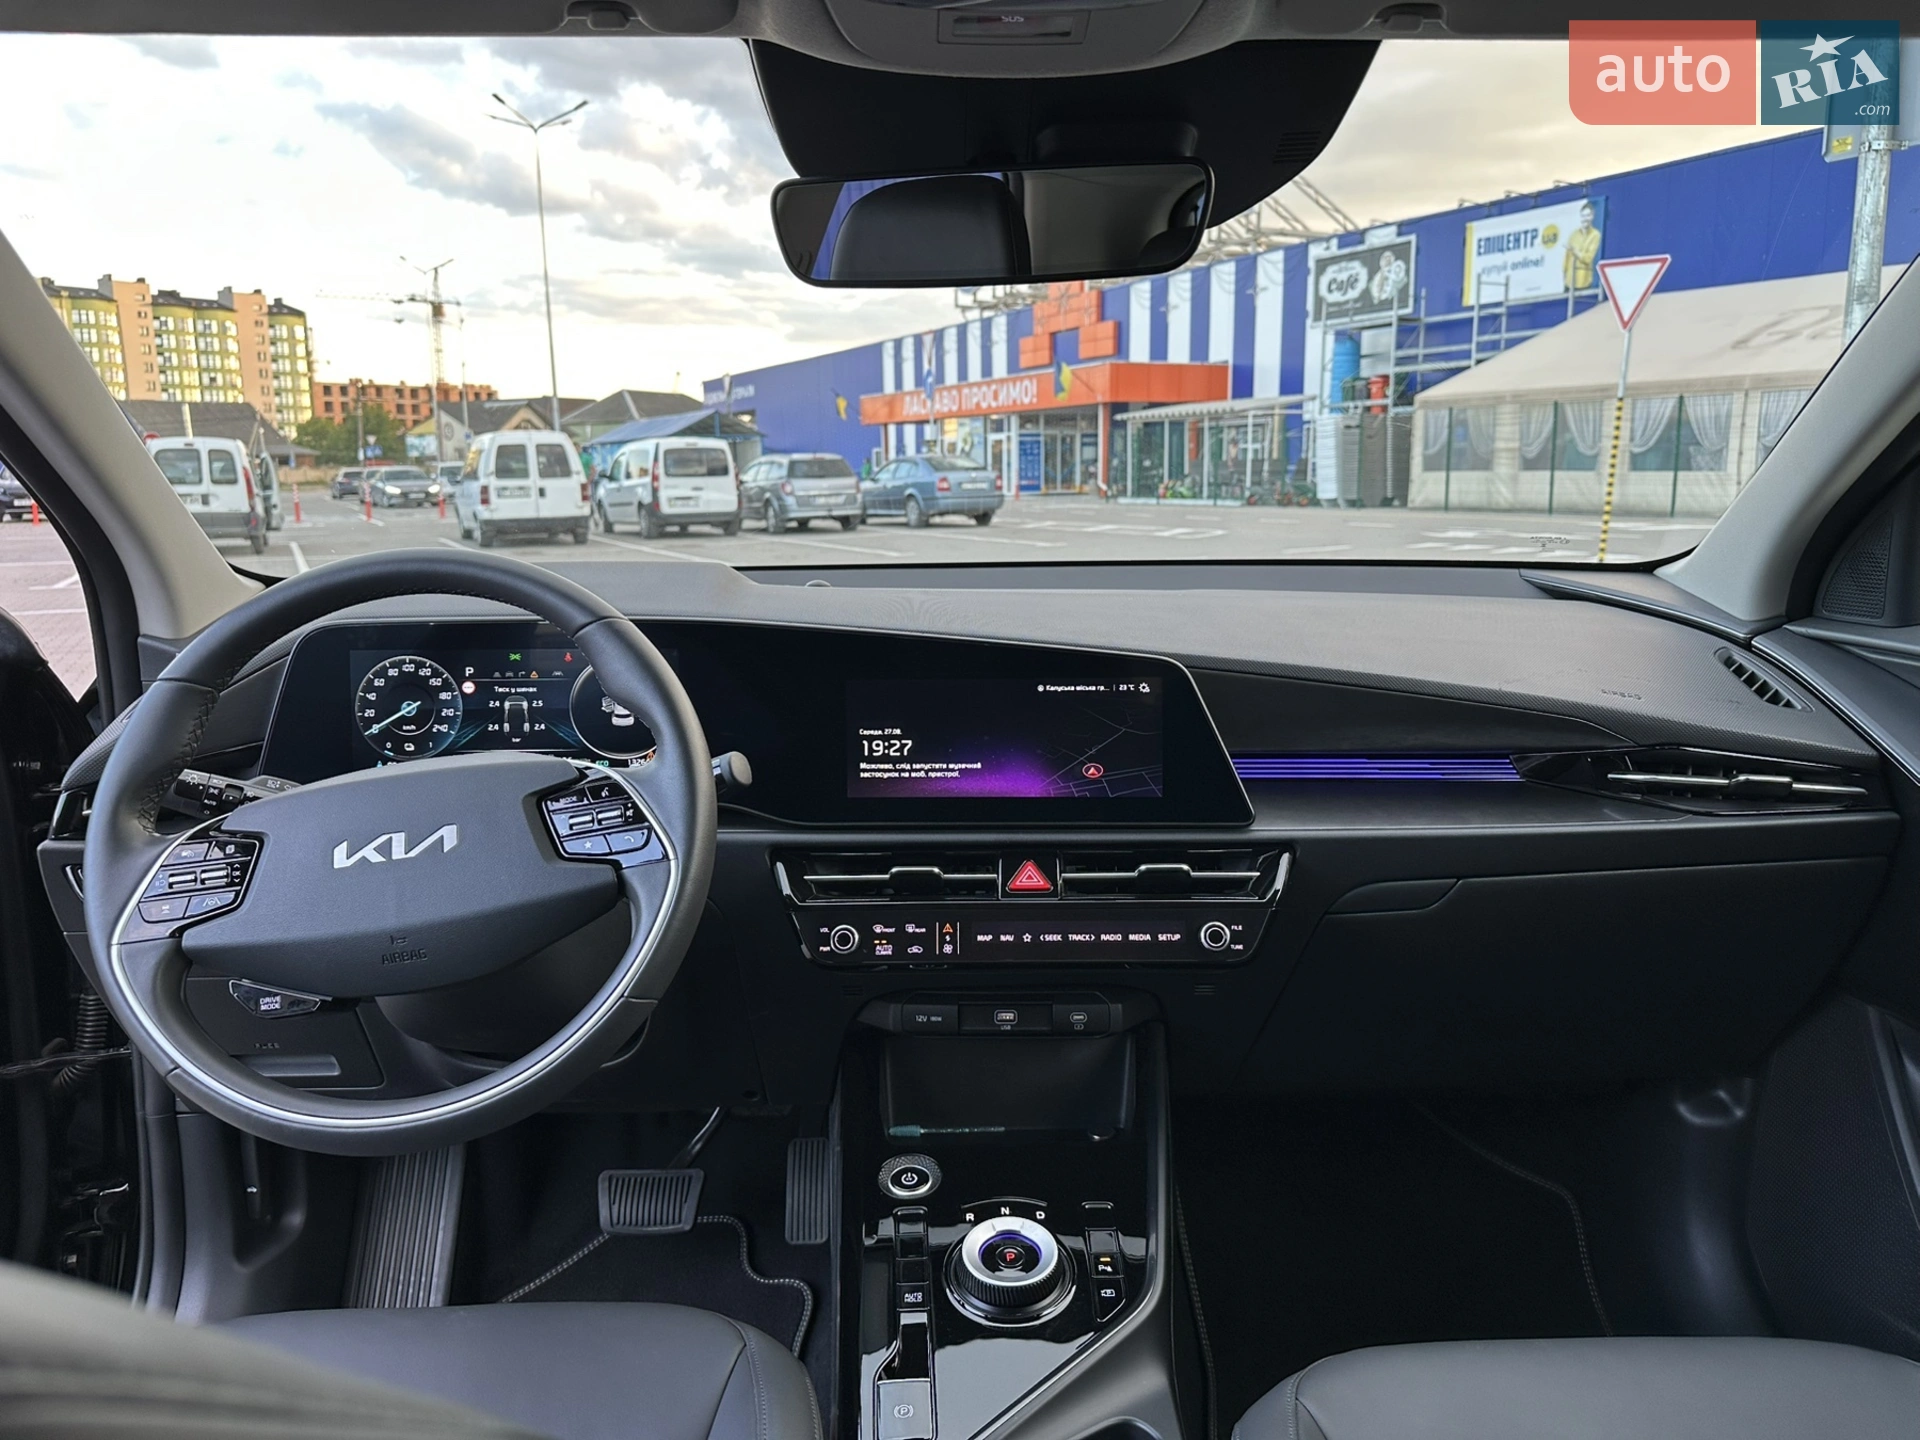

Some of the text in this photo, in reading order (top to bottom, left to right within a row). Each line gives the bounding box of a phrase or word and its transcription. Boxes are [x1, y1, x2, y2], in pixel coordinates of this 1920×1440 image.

[1477, 228, 1539, 256] ЕПІЦЕНТР
[903, 378, 1038, 417] ЛАСАВО ПРОСИМО!
[387, 668, 399, 676] 80
[402, 664, 415, 672] 100
[418, 668, 432, 676] 120
[465, 667, 475, 677] P
[374, 678, 385, 686] 60
[429, 678, 442, 686] 150
[439, 692, 452, 700] 180
[364, 709, 375, 717] 20
[441, 708, 455, 716] 210
[432, 724, 449, 732] 240
[534, 723, 546, 731] 2.4
[862, 740, 912, 756] 19:27
[1100, 934, 1122, 942] RADIO
[1128, 934, 1152, 942] MEDIA
[1158, 934, 1182, 942] SETUP
[381, 948, 428, 966] AIRBAG
[260, 995, 282, 1004] DRIVE
[260, 1002, 281, 1010] MODE
[1000, 1206, 1010, 1215] N
[966, 1213, 974, 1221] R
[1036, 1211, 1045, 1220] D
[1006, 1252, 1016, 1262] P
